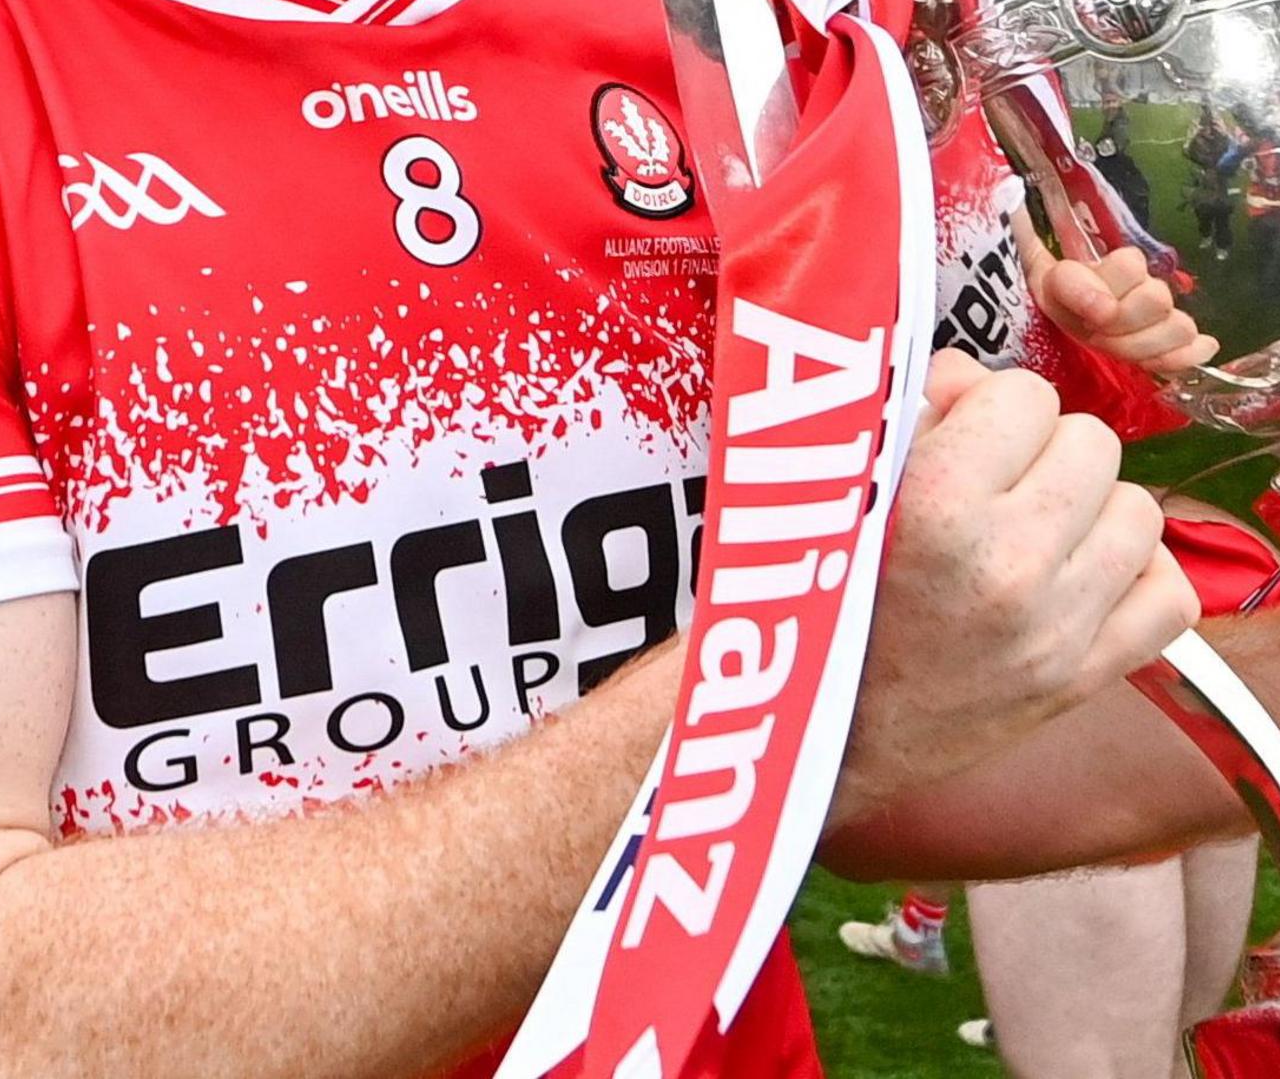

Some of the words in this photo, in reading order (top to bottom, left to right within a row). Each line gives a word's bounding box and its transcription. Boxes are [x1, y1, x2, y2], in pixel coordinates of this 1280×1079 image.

[302, 71, 478, 129] o'neills
[380, 134, 483, 268] 8
[604, 237, 652, 257] ALLIANZ
[654, 235, 709, 255] FOOTBALL
[623, 259, 670, 279] DIVISION
[85, 458, 708, 729] Errig
[621, 297, 885, 951] Allianz
[123, 651, 560, 793] GROUP
